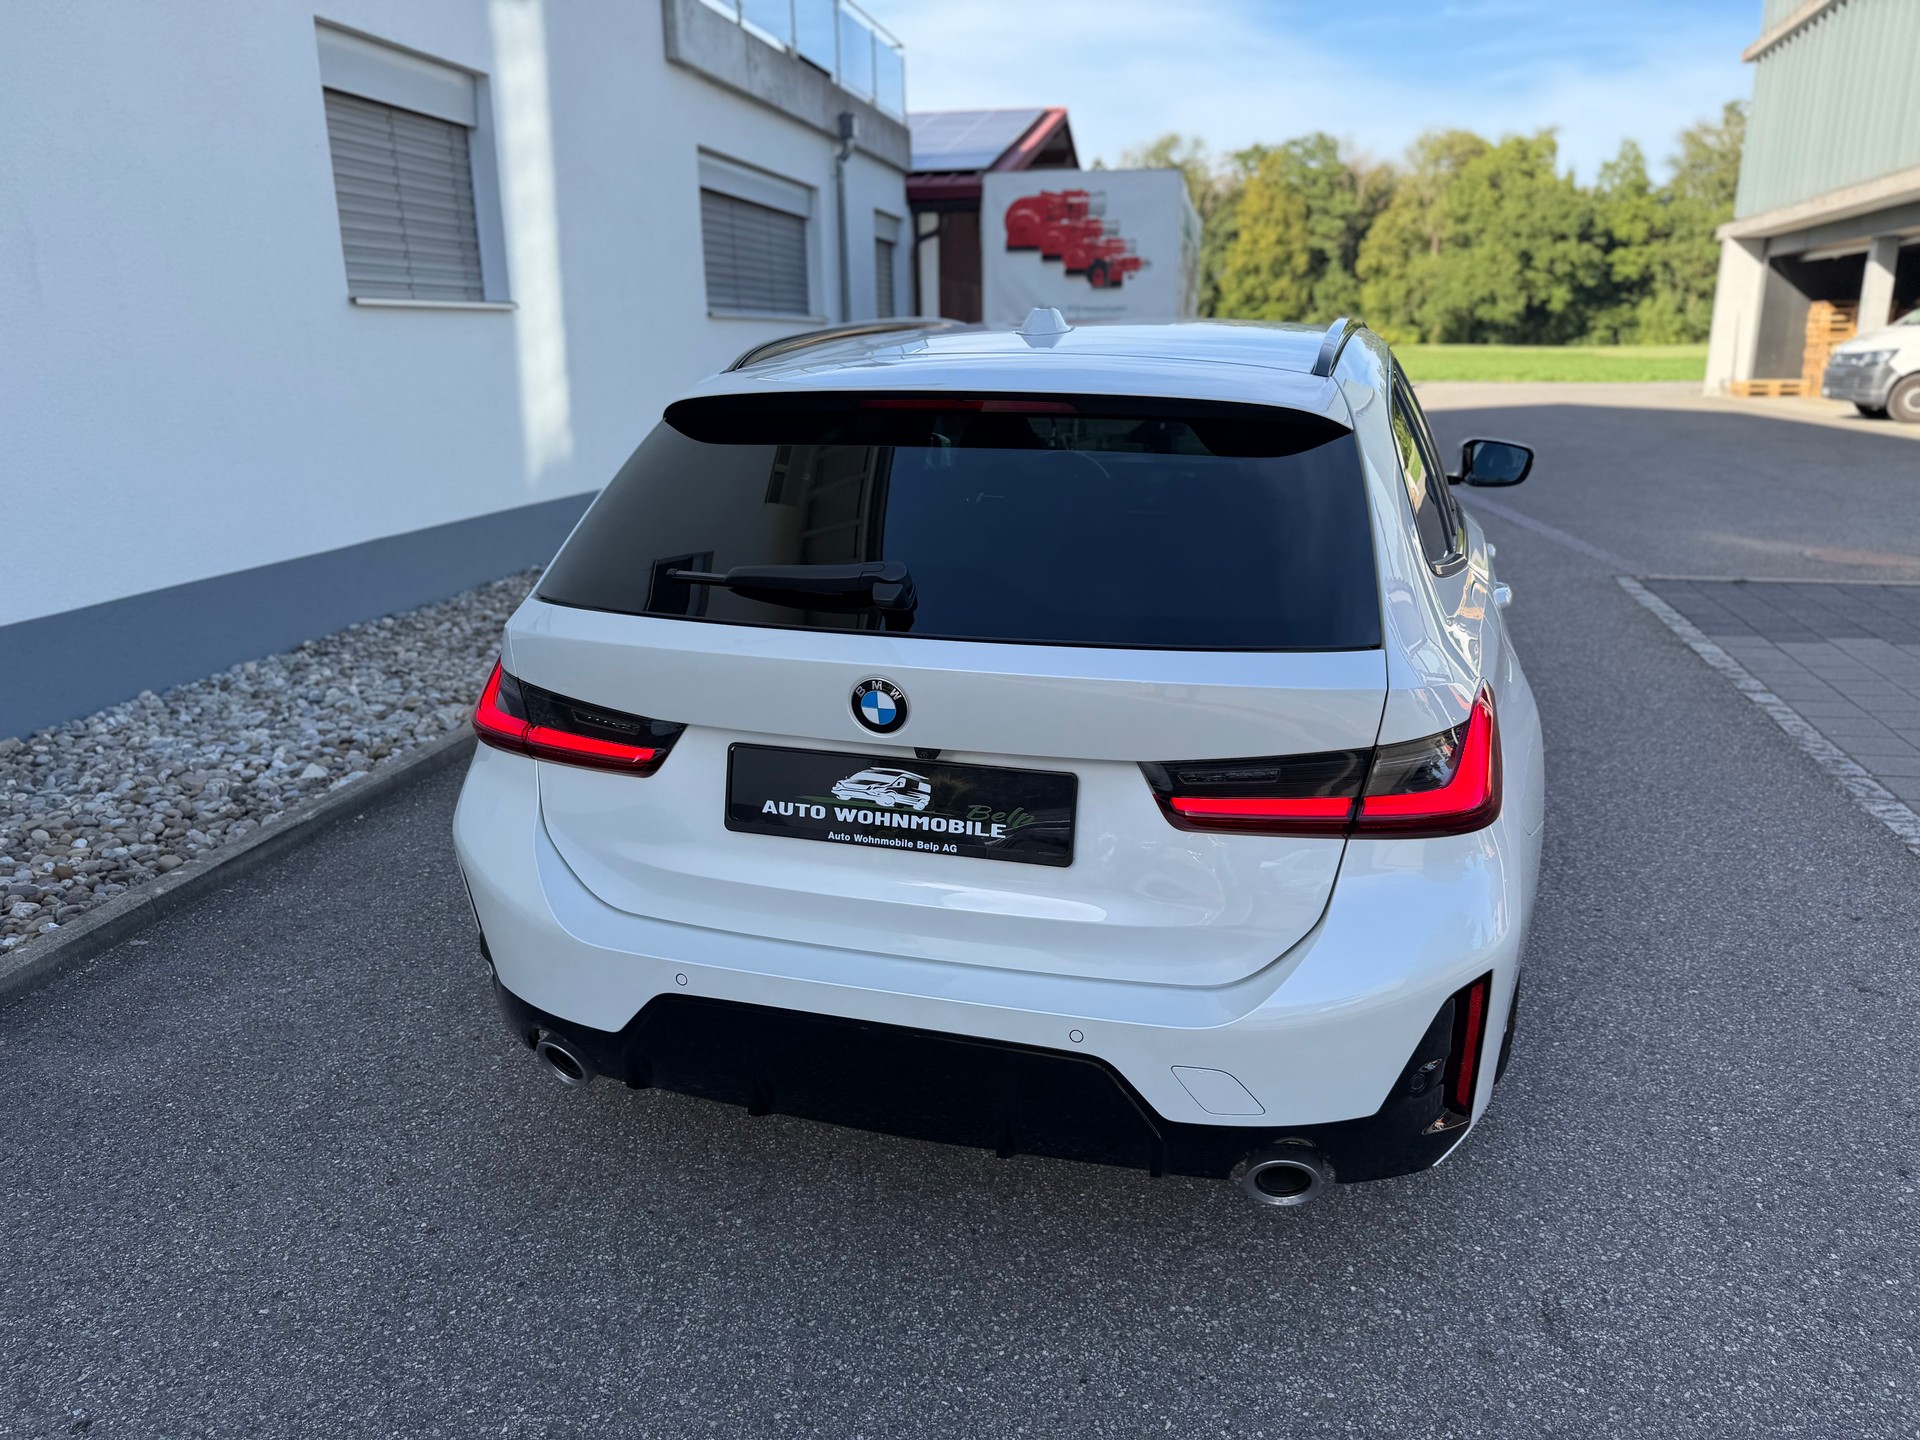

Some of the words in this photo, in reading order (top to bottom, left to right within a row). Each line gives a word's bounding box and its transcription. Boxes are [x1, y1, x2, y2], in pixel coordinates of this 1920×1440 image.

[855, 680, 902, 700] BMW
[762, 800, 826, 819] AUTO
[834, 807, 1006, 838] WOHNMOBILE
[966, 804, 1035, 828] Belp
[828, 831, 850, 841] Auto
[854, 834, 913, 848] Wohnmobile
[917, 841, 939, 852] Belp
[942, 844, 958, 853] AG
